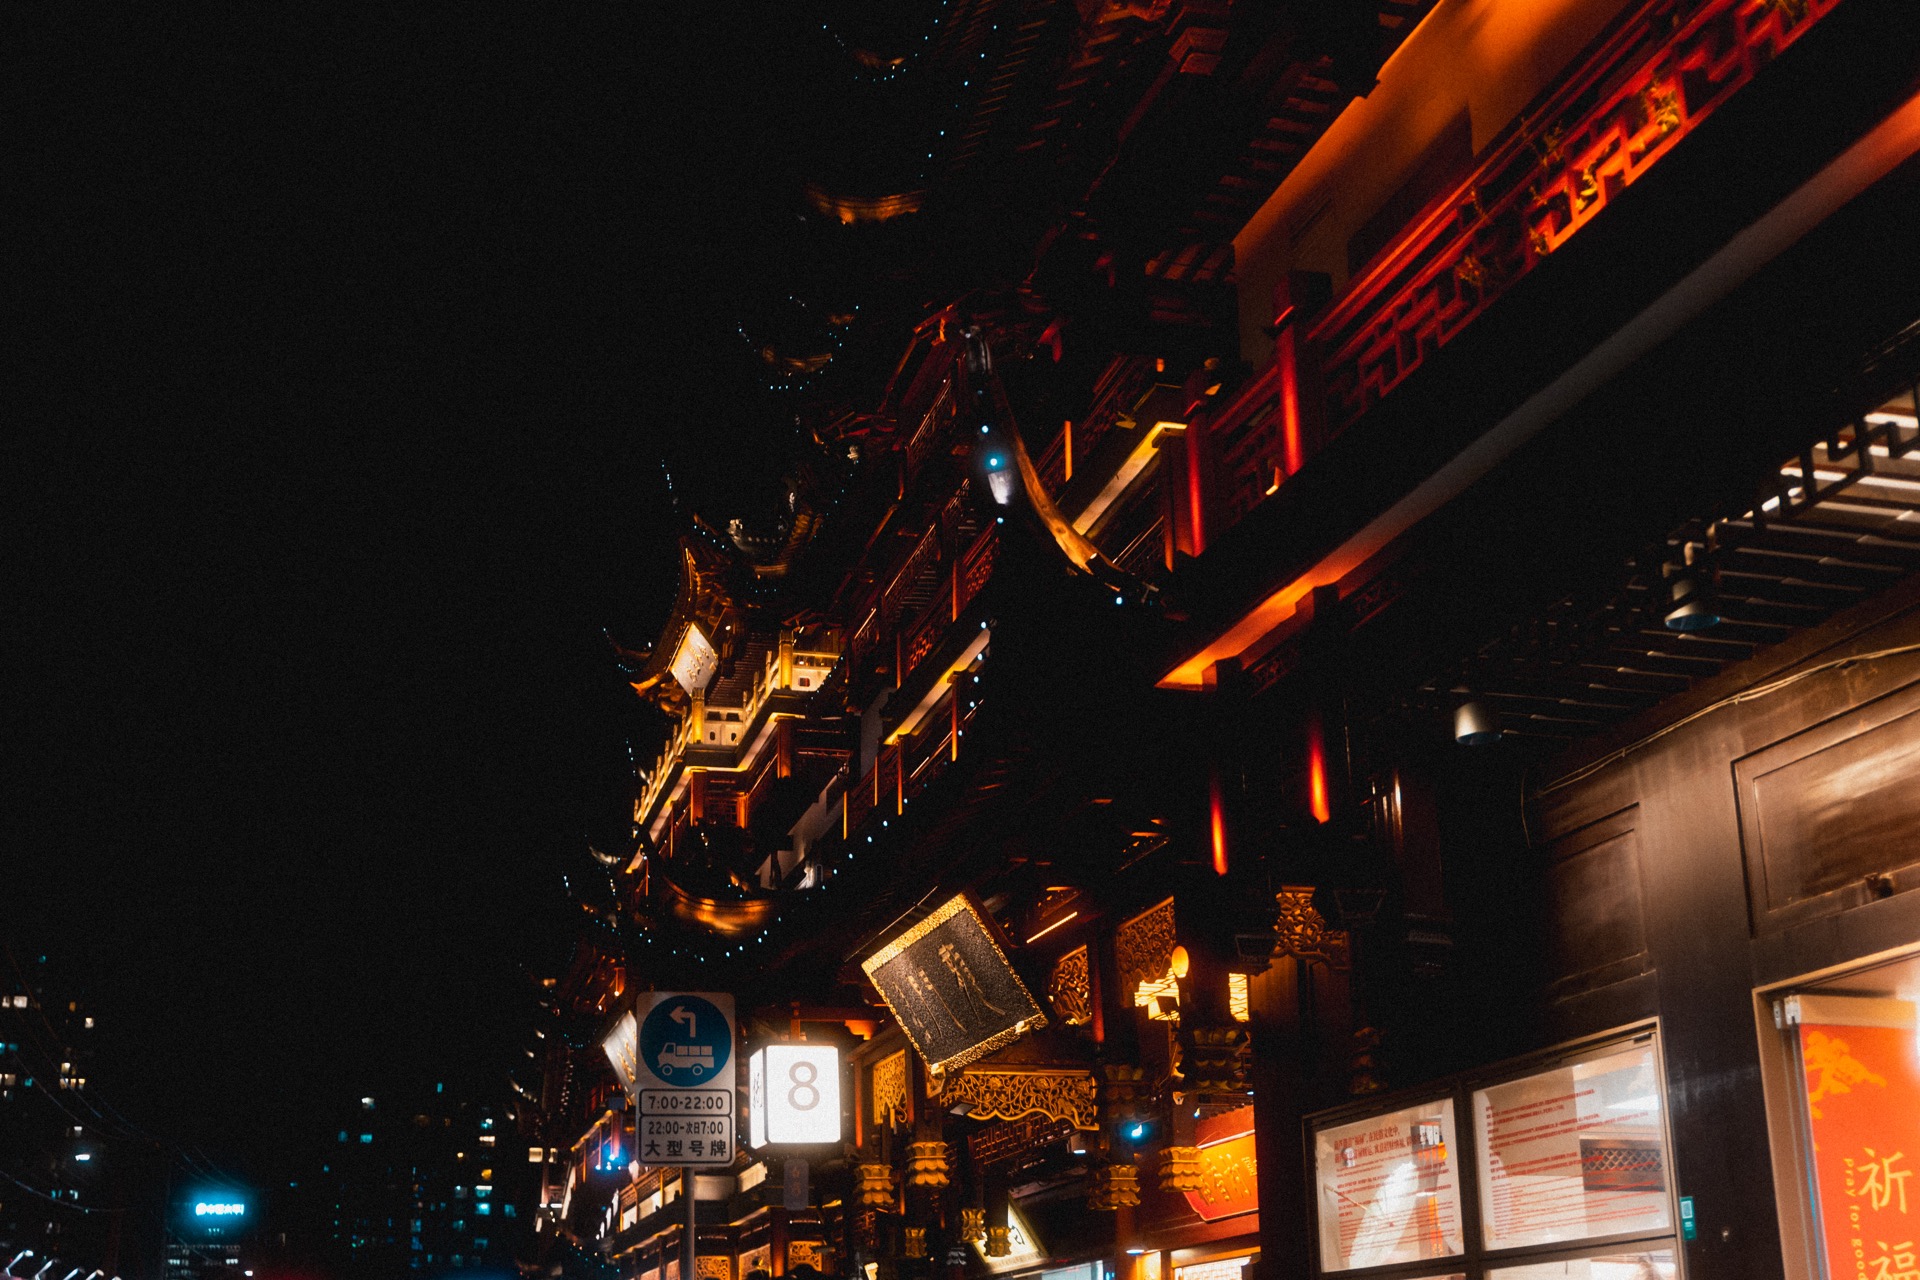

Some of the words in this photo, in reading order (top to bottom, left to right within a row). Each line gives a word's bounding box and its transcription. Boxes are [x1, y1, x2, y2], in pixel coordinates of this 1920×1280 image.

[787, 1061, 820, 1111] 8
[648, 1096, 724, 1110] 7:00-22:00
[644, 1139, 727, 1157] 大型号牌
[1849, 1204, 1861, 1231] for
